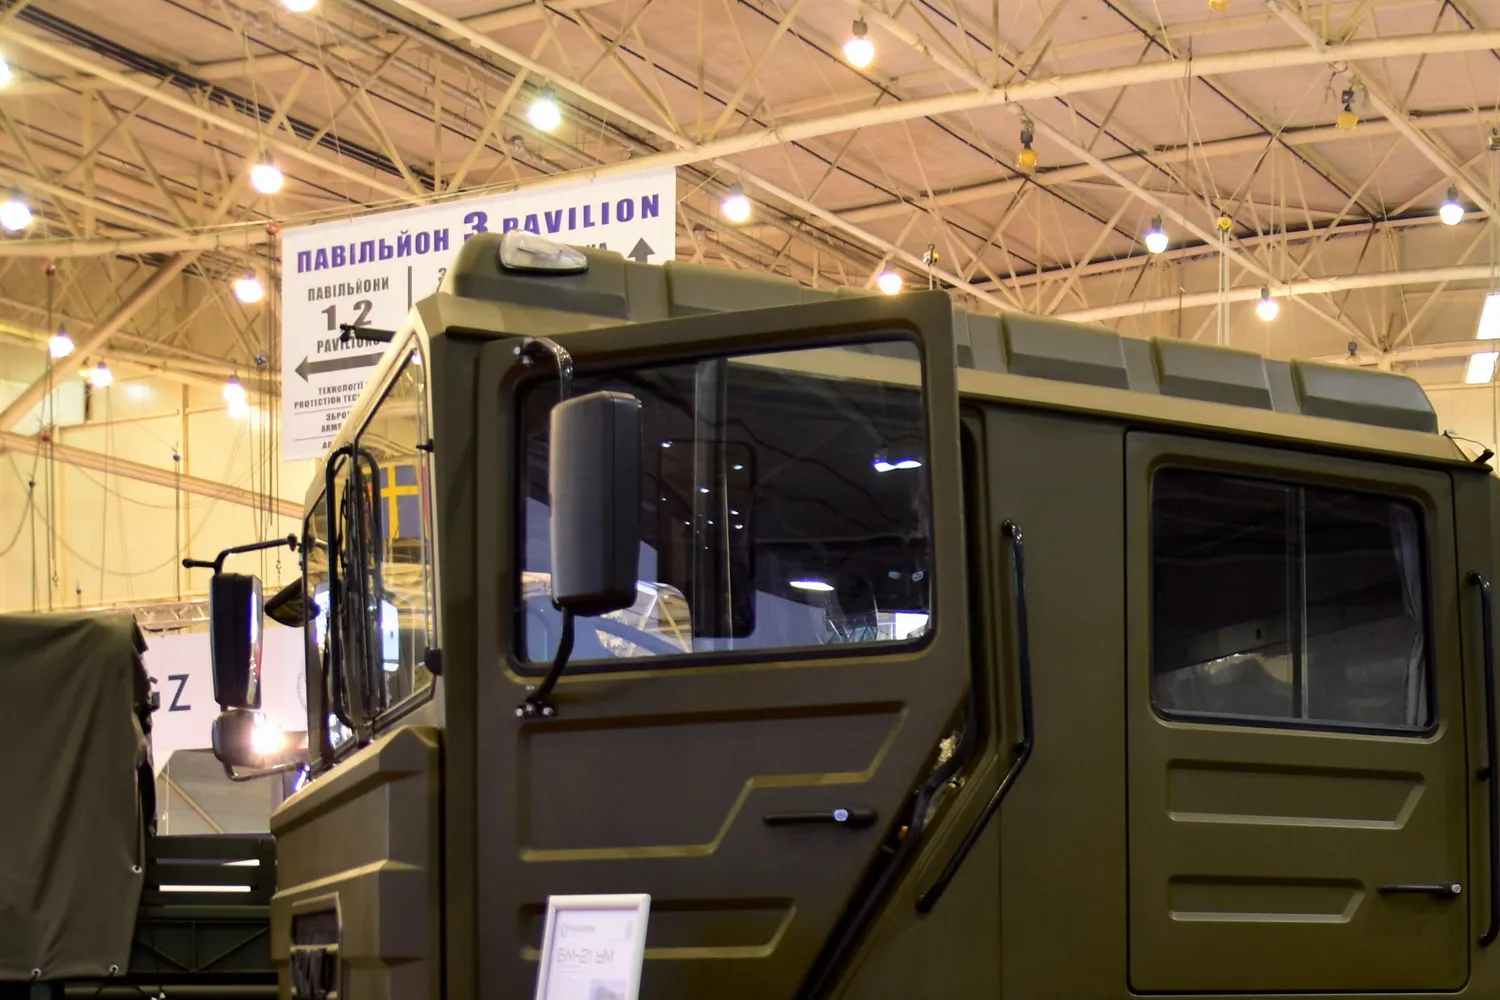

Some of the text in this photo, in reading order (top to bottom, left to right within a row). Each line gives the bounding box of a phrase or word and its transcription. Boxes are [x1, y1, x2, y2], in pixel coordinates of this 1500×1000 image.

[297, 194, 660, 274] ПАВІЛЬЙОН 3 PAVILION
[307, 277, 389, 302] ПАВІЛЬЙОНИ
[321, 299, 373, 331] 1 2
[326, 411, 350, 421] ЗБРО
